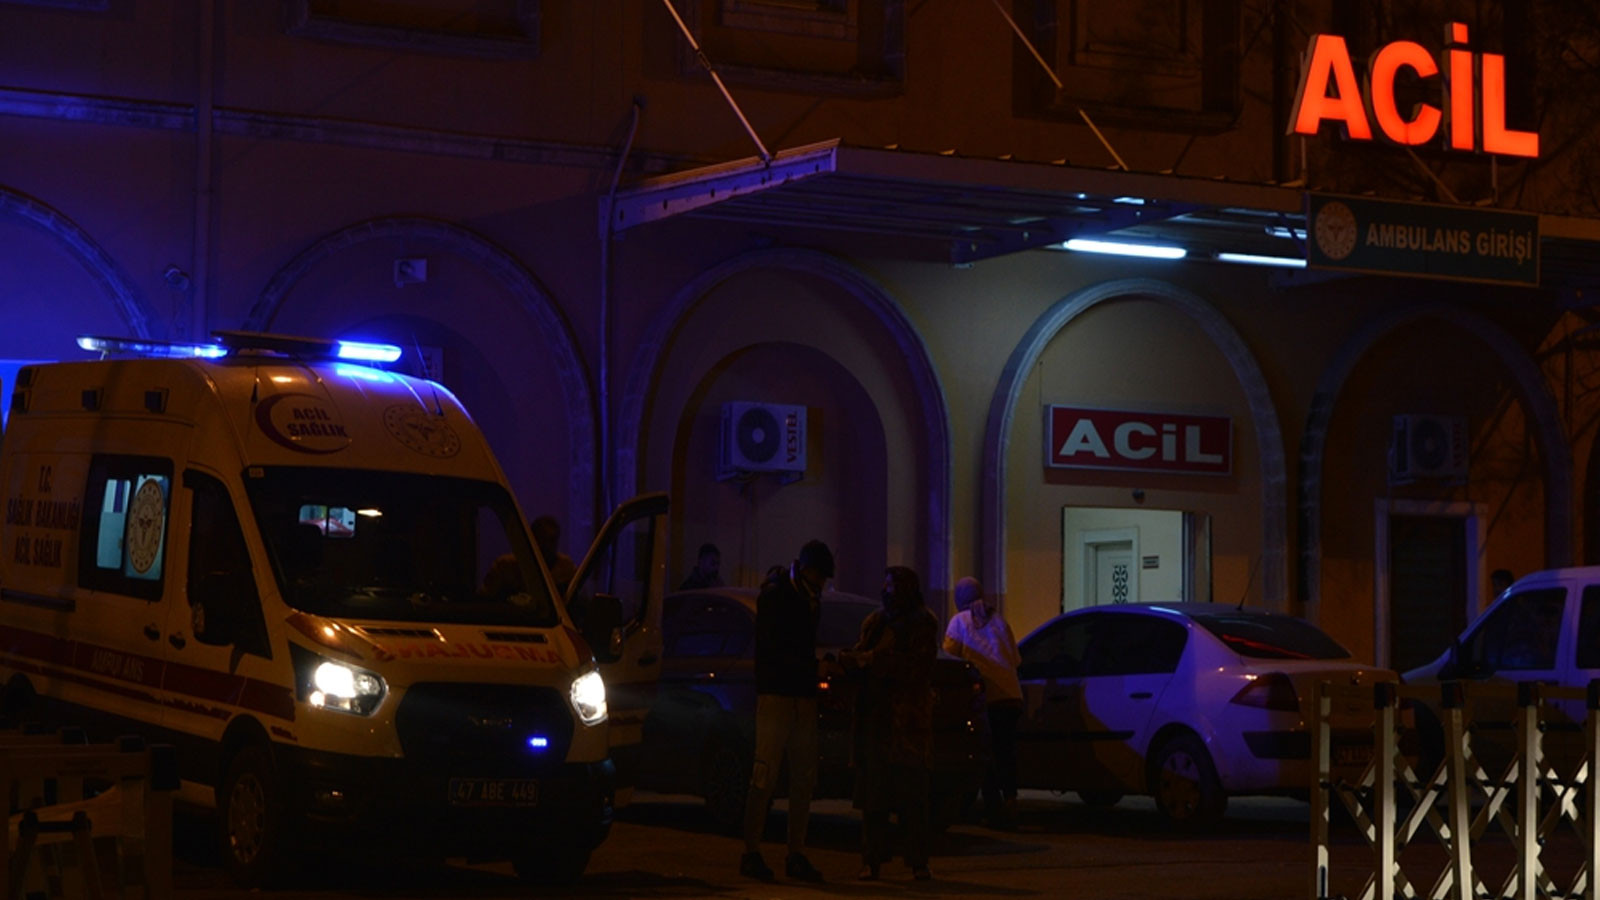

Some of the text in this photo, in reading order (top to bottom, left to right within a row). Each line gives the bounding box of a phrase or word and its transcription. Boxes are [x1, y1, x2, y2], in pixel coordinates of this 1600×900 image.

[1287, 20, 1540, 159] ACİL
[1366, 222, 1533, 266] AMBULANS GİRİŞİ
[286, 422, 349, 438] SAĞLIK
[293, 407, 331, 421] ACİL
[786, 411, 798, 463] VESTEL
